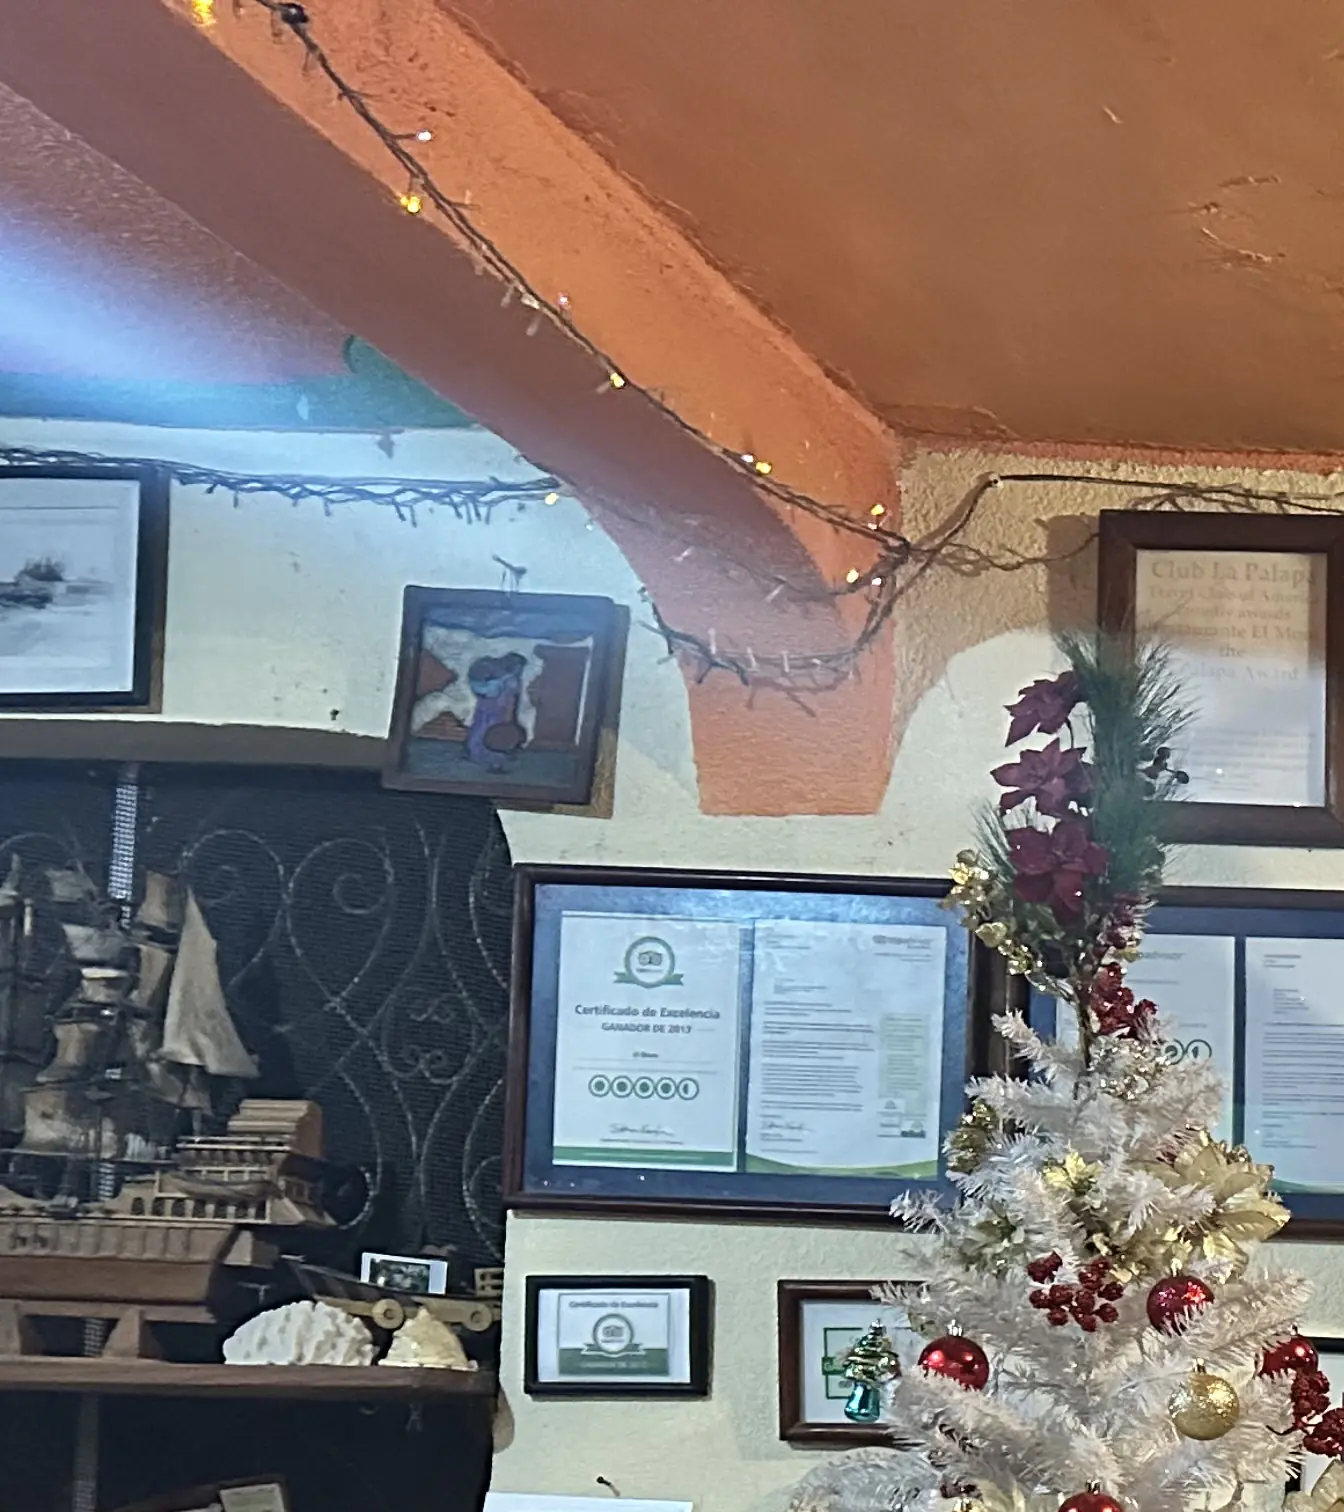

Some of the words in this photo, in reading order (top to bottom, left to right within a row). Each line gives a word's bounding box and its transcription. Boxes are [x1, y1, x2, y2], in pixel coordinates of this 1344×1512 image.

[1151, 561, 1205, 579] Club
[1211, 561, 1238, 580] La
[575, 1004, 639, 1016] Certificado
[642, 1007, 657, 1017] de
[660, 1007, 720, 1019] Excelencia
[601, 1022, 650, 1033] GANADOR
[652, 1023, 665, 1033] DE
